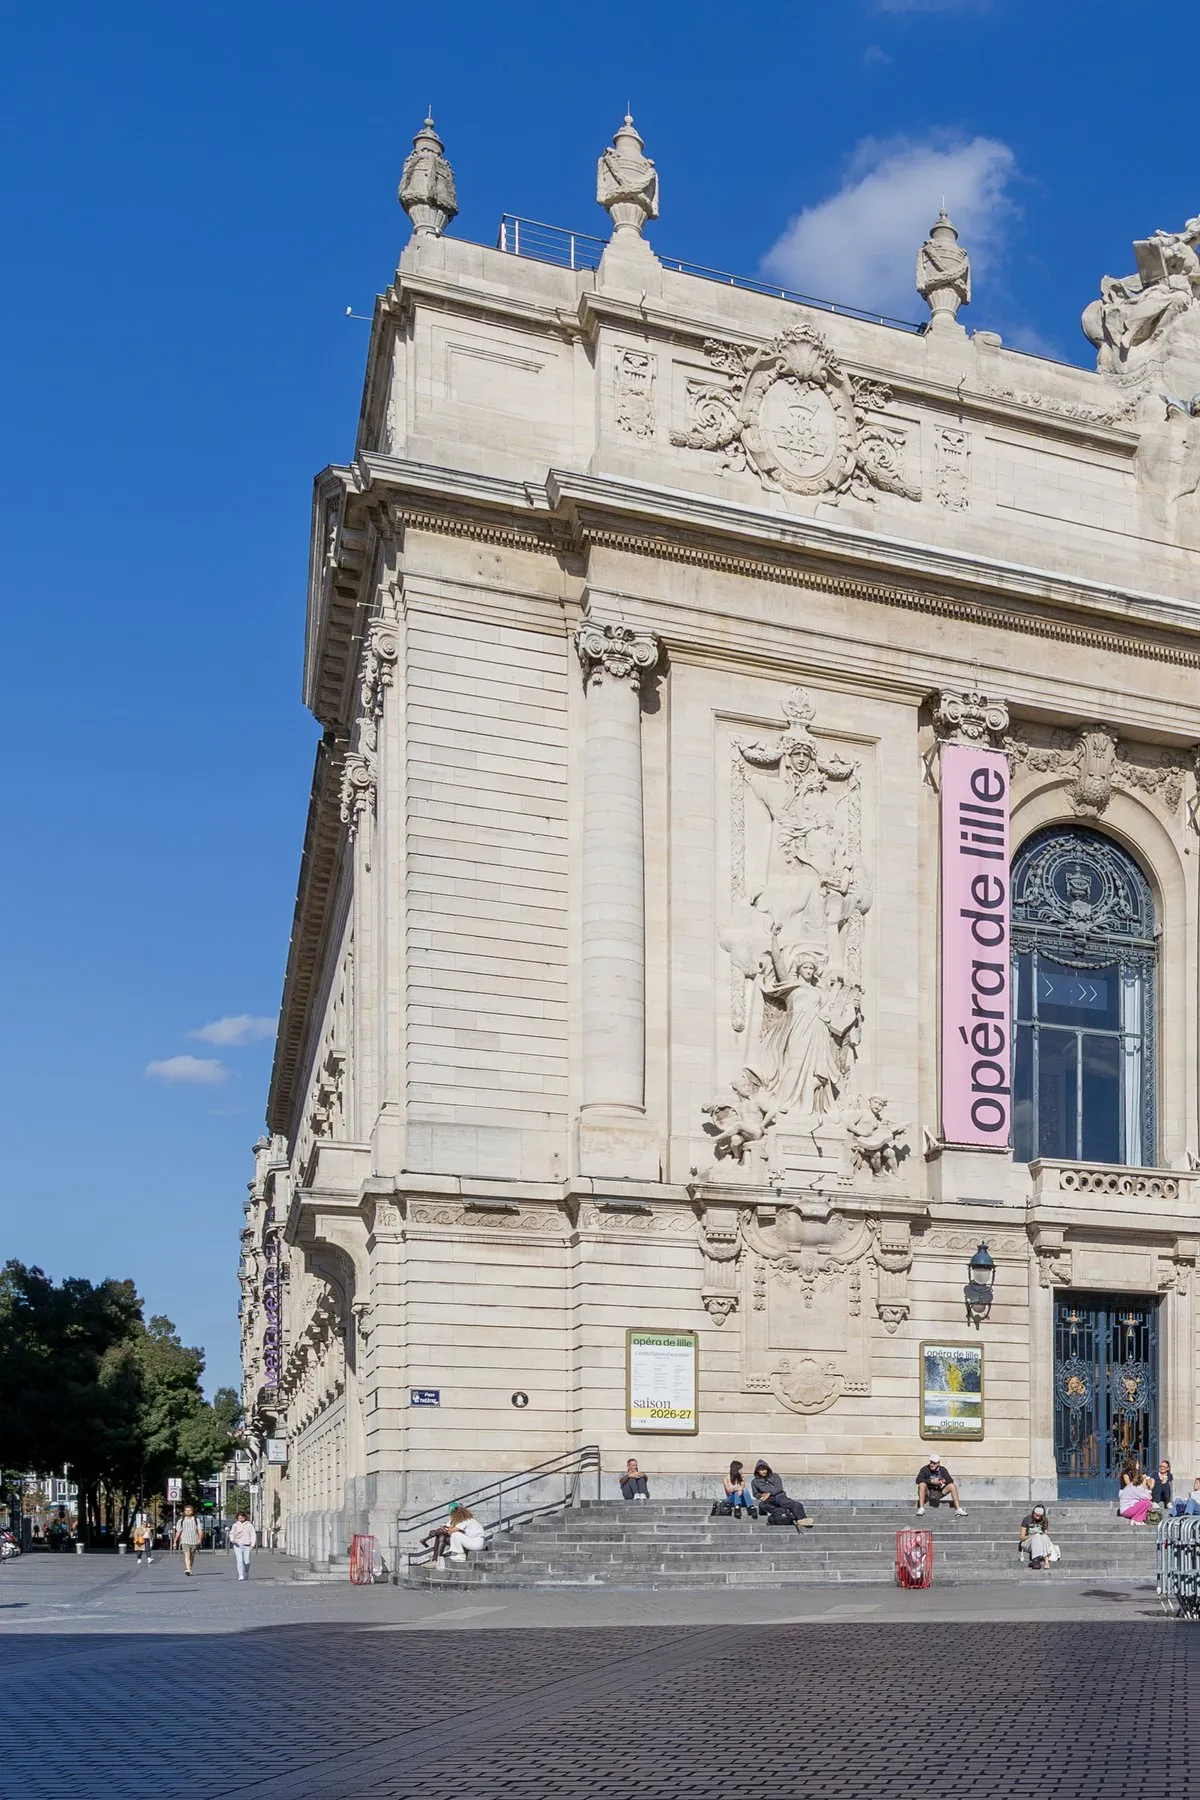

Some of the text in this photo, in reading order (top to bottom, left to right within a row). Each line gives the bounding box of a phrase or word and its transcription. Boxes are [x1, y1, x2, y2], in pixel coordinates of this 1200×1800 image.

[958, 767, 1011, 1132] opéra de lille
[264, 1297, 280, 1389] Mercure
[633, 1337, 693, 1348] opéra de lille
[926, 1349, 979, 1360] opéra de lille
[633, 1397, 671, 1409] saison
[650, 1408, 692, 1419] 2026-27
[940, 1419, 965, 1428] alcina
